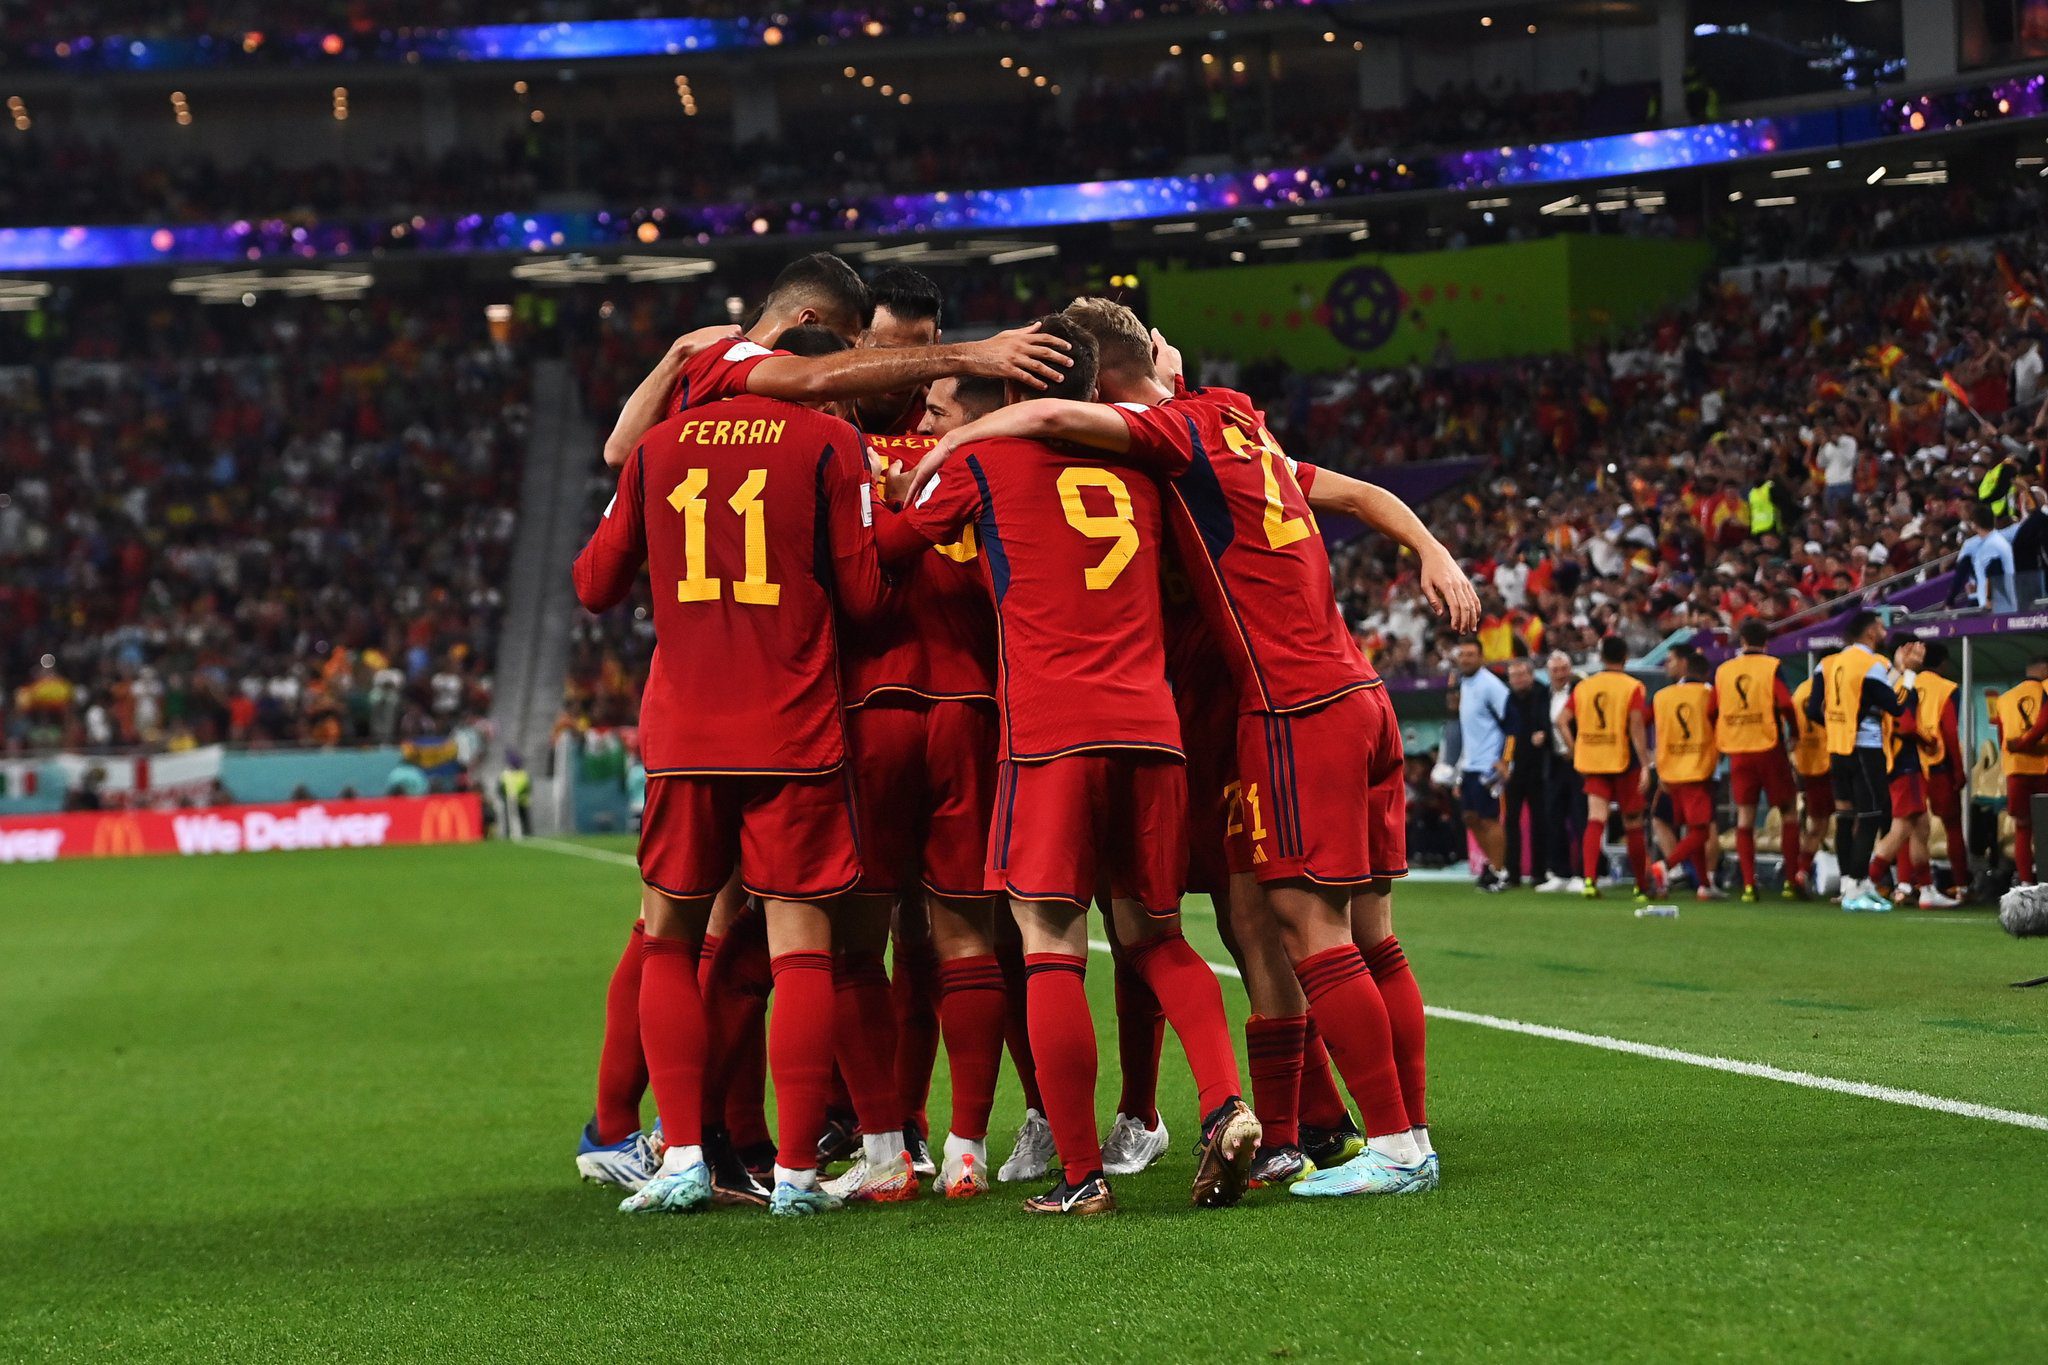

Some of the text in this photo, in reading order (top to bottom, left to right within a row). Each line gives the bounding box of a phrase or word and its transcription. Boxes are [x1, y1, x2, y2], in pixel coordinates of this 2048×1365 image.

[678, 419, 786, 445] FERRAN
[666, 468, 781, 606] 11
[1056, 467, 1140, 590] 9
[173, 805, 391, 856] We Deliver
[1223, 779, 1267, 841] 21
